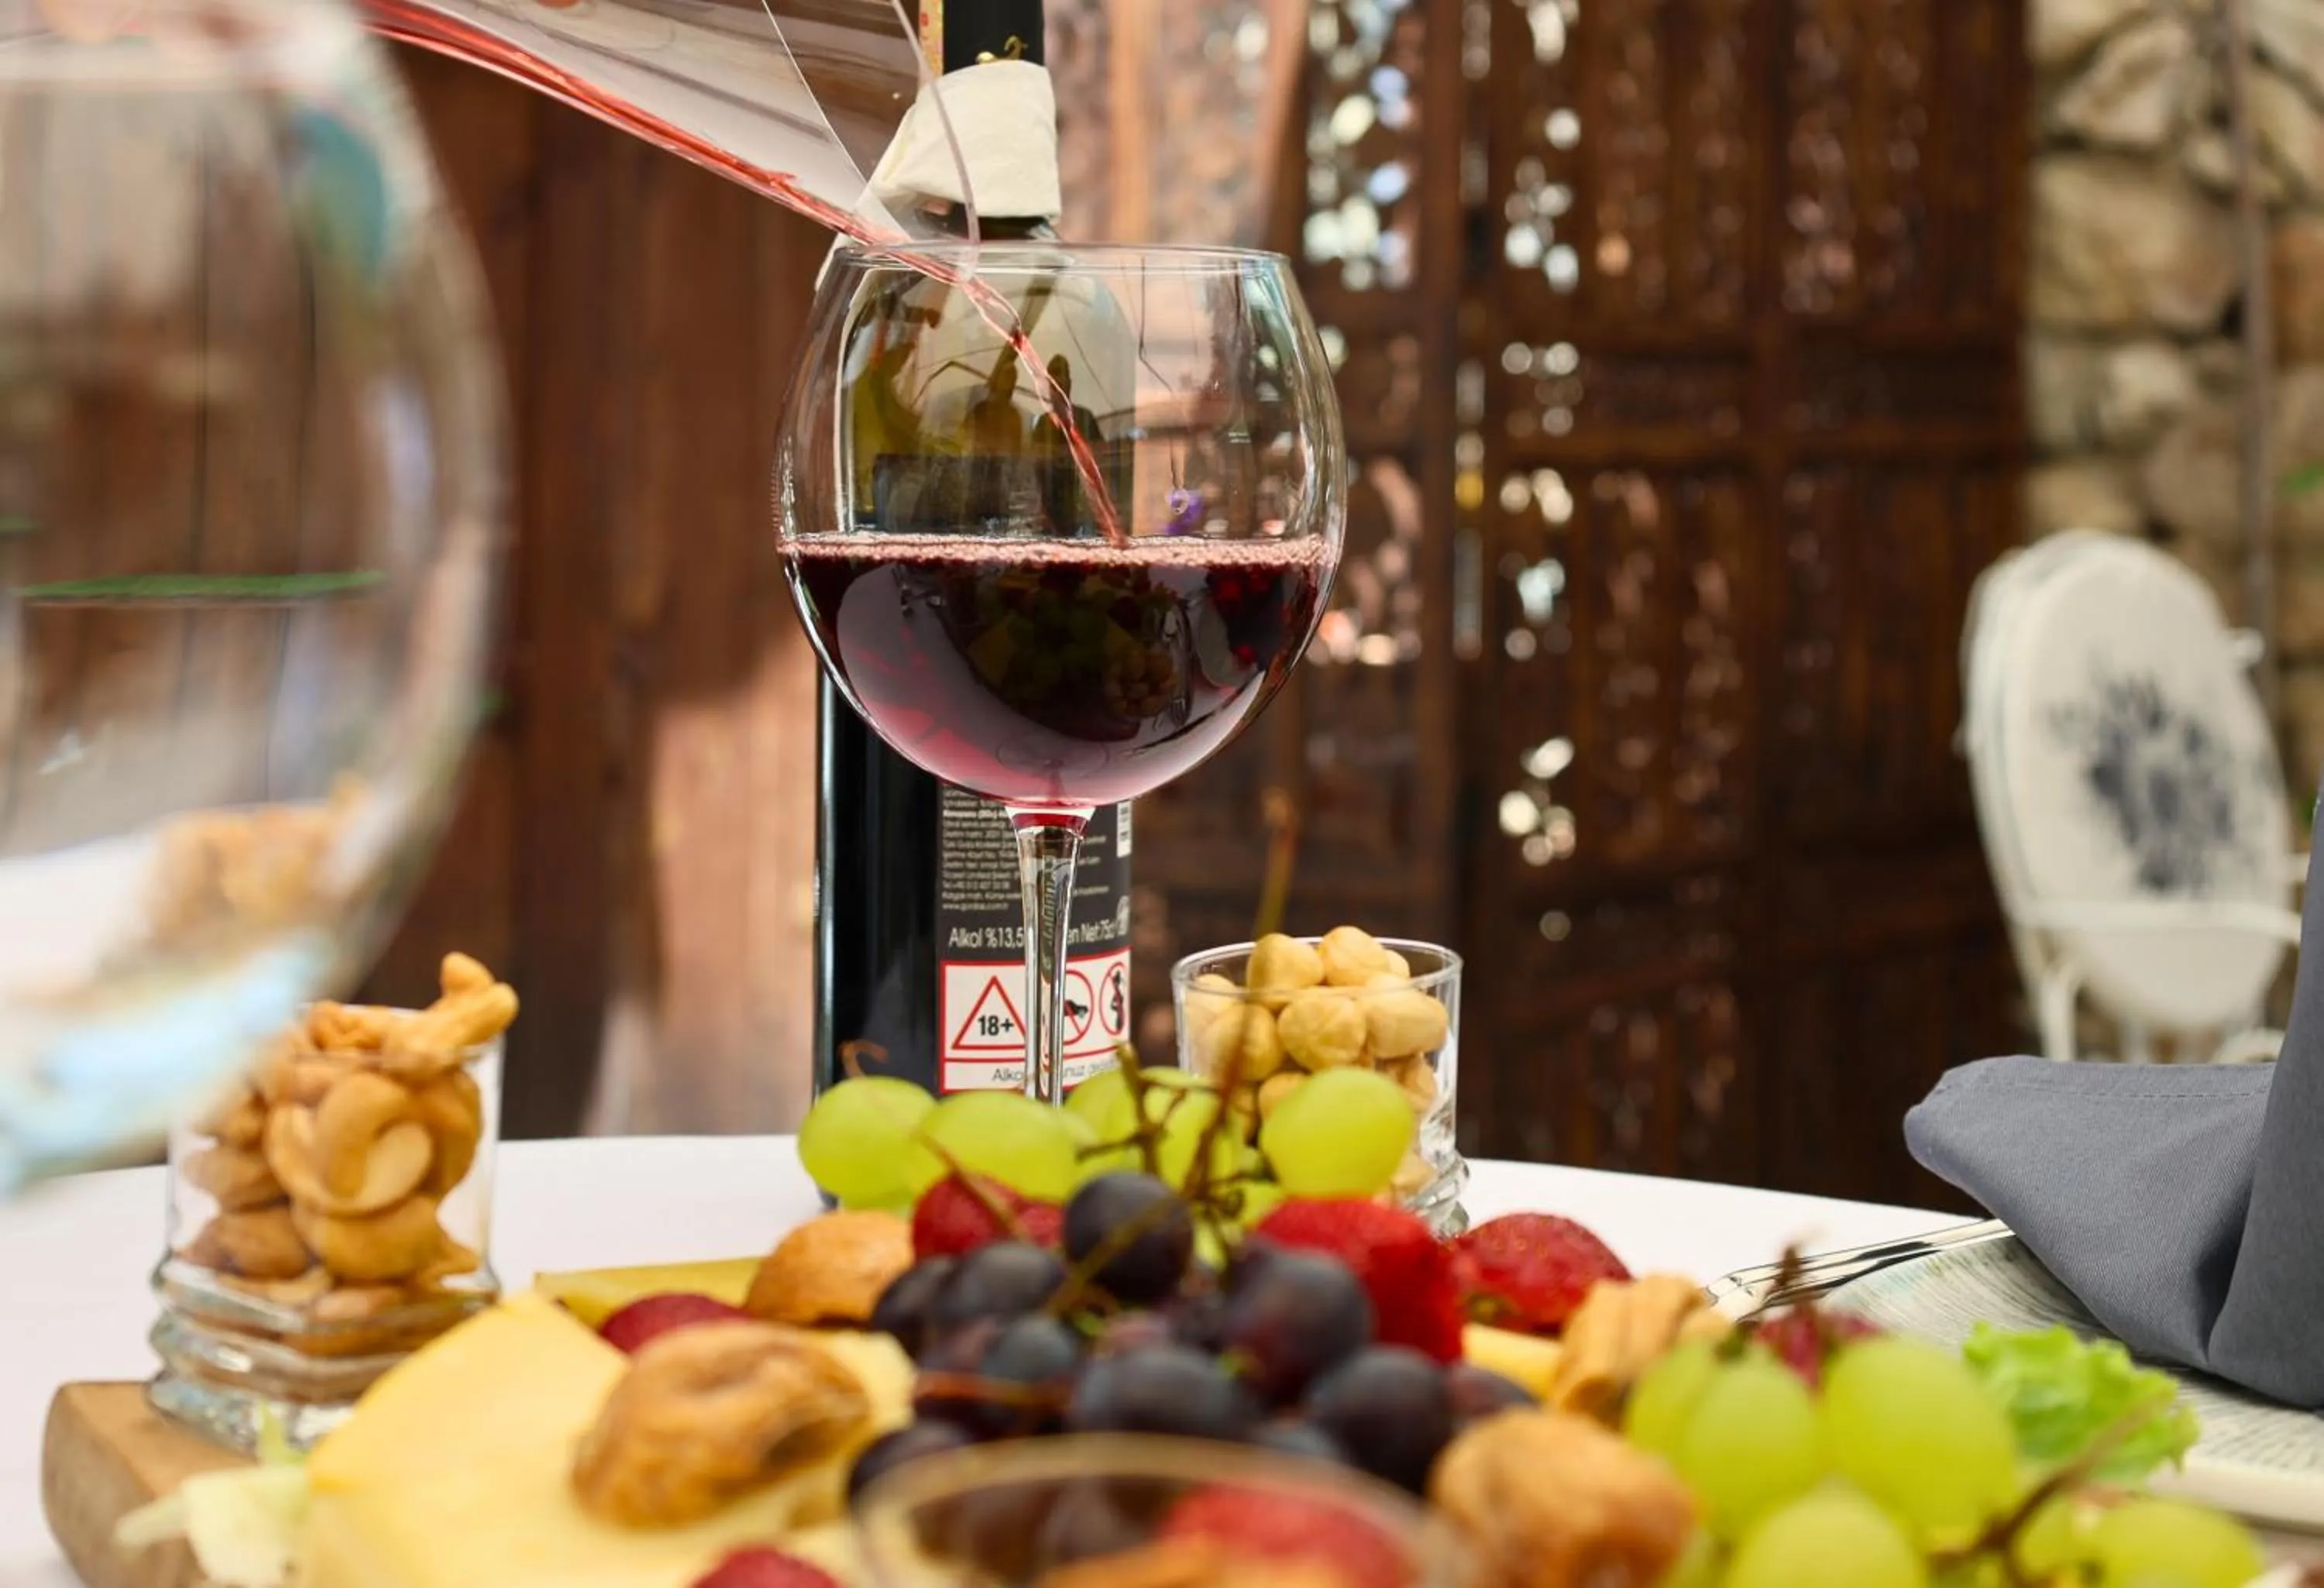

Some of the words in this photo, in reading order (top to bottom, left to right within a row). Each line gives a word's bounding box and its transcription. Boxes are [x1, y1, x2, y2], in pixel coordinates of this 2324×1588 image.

[948, 927, 983, 948] Alkol
[978, 1015, 1014, 1036] 18+
[992, 1068, 1023, 1081] Alko
